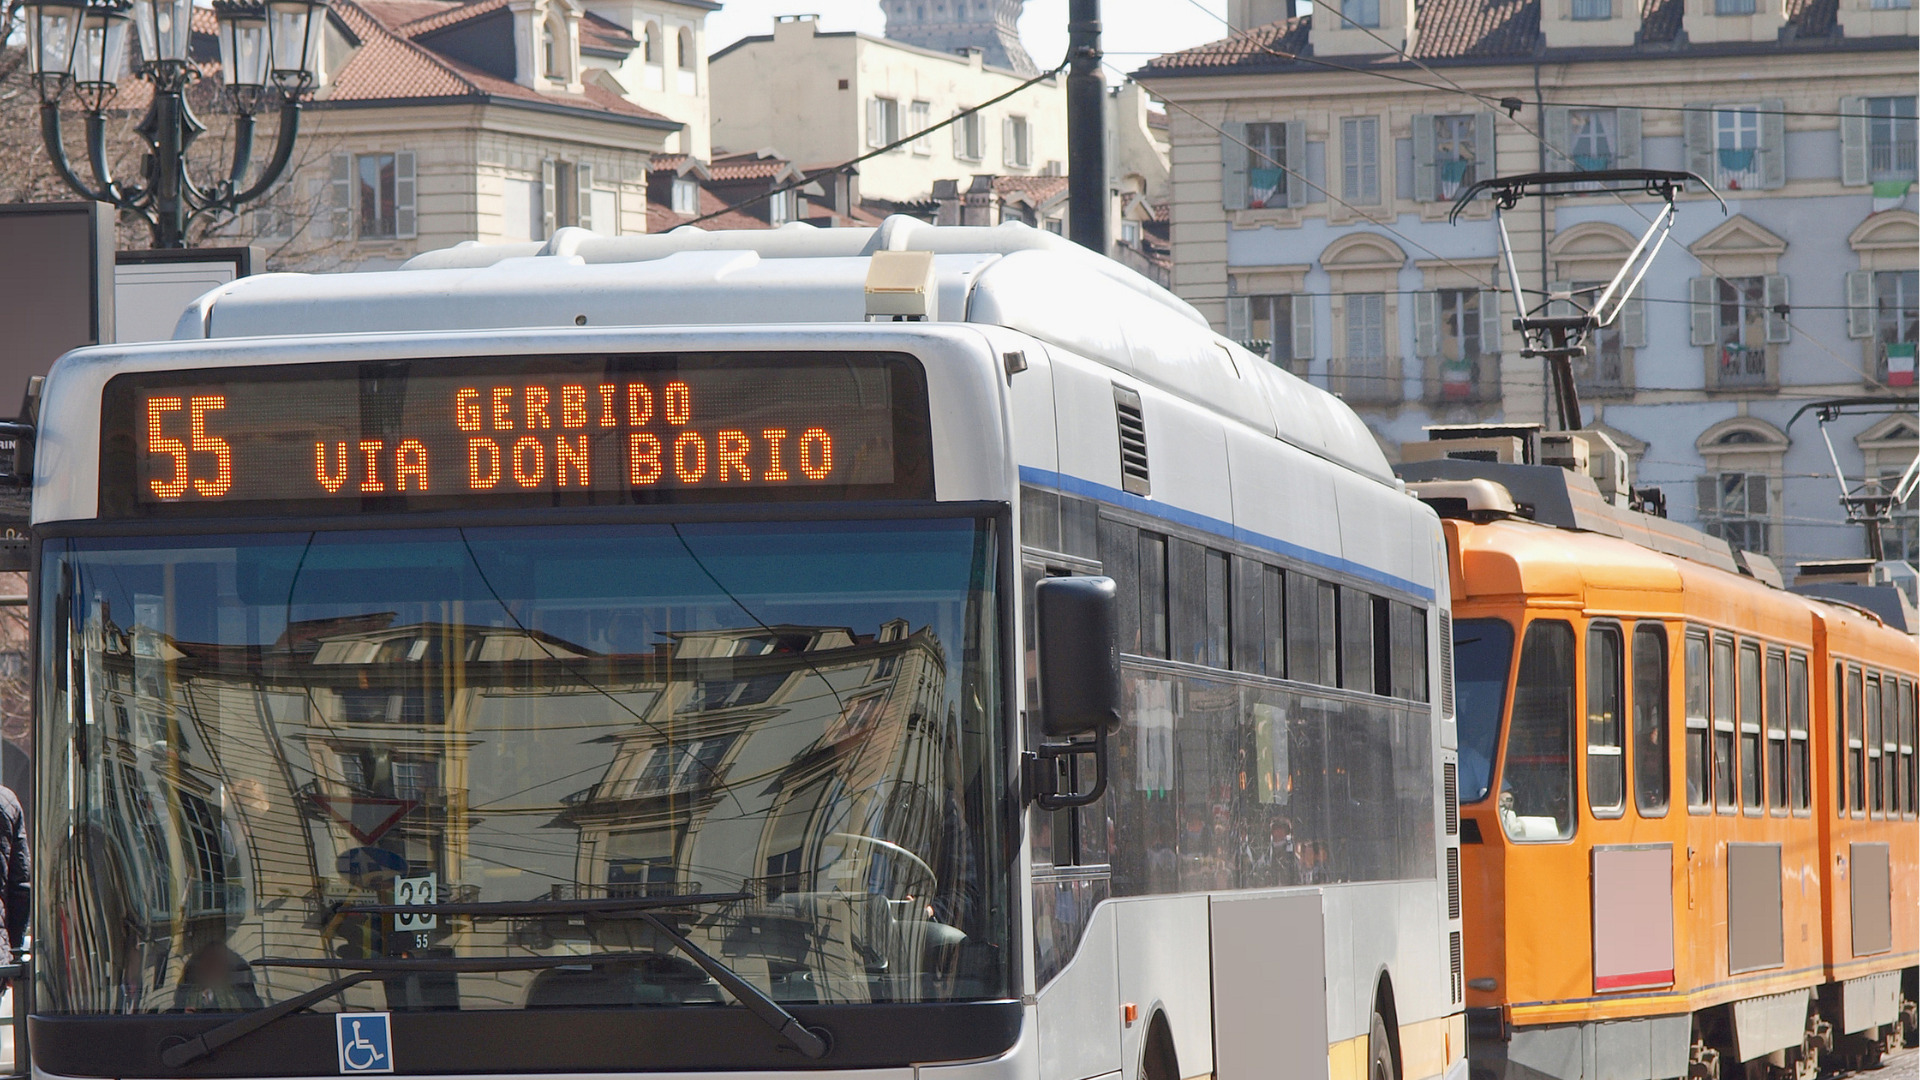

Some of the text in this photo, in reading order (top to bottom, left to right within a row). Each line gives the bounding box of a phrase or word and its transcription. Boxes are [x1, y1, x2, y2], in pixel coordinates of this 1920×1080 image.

[456, 382, 691, 432] GERBIDO
[147, 395, 232, 498] 55
[315, 427, 833, 493] VIA DON BORIO
[400, 880, 432, 926] 33
[416, 933, 429, 949] 55
